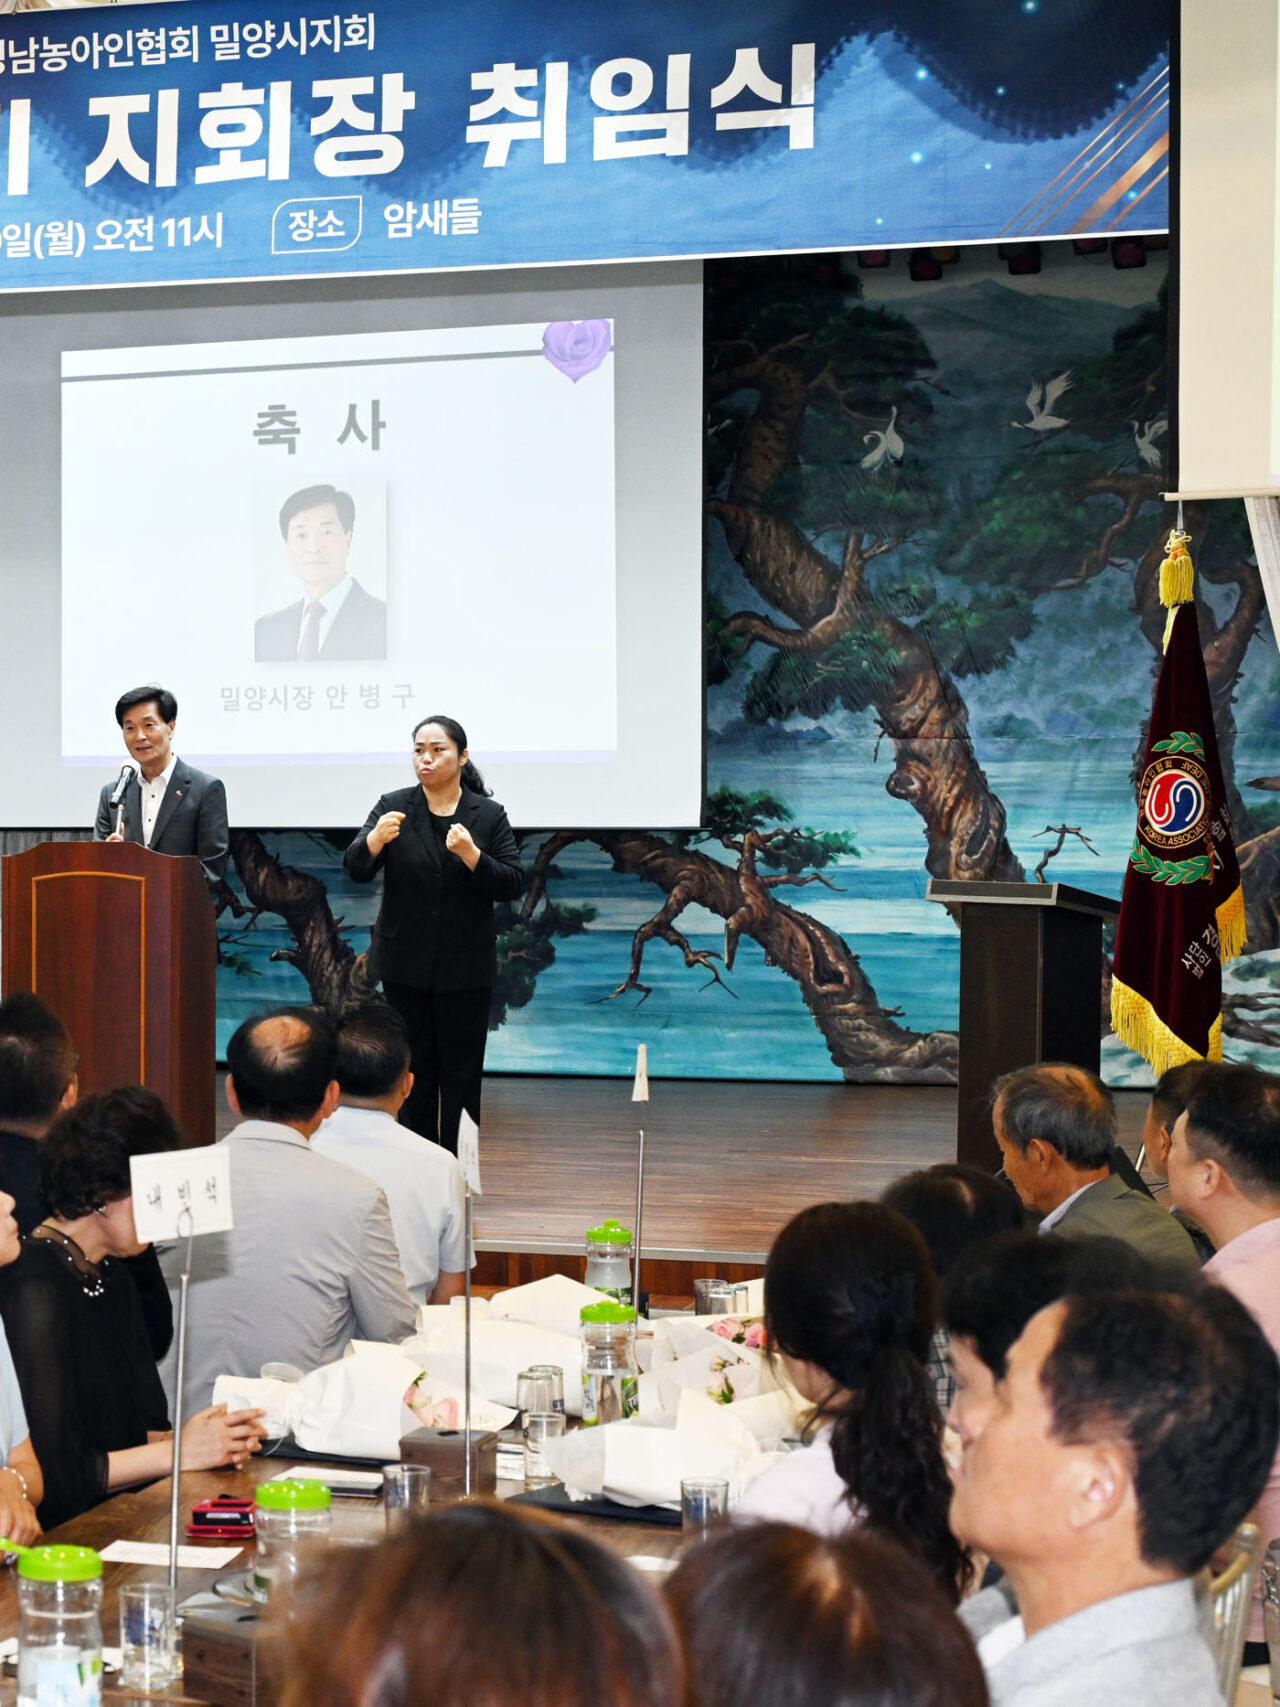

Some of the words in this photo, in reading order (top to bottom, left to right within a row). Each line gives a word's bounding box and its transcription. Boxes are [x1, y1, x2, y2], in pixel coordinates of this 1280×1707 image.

[210, 14, 376, 61] 밀양시지회
[84, 72, 416, 190] 지회장
[465, 43, 816, 169] 취임식
[92, 215, 155, 253] 오전
[160, 210, 223, 249] 11시
[287, 209, 346, 241] 장소
[383, 197, 483, 239] 암새들
[252, 404, 301, 455] 축
[336, 399, 387, 451] 사
[220, 685, 315, 713] 밀양시장
[1144, 824, 1167, 846] KOREA
